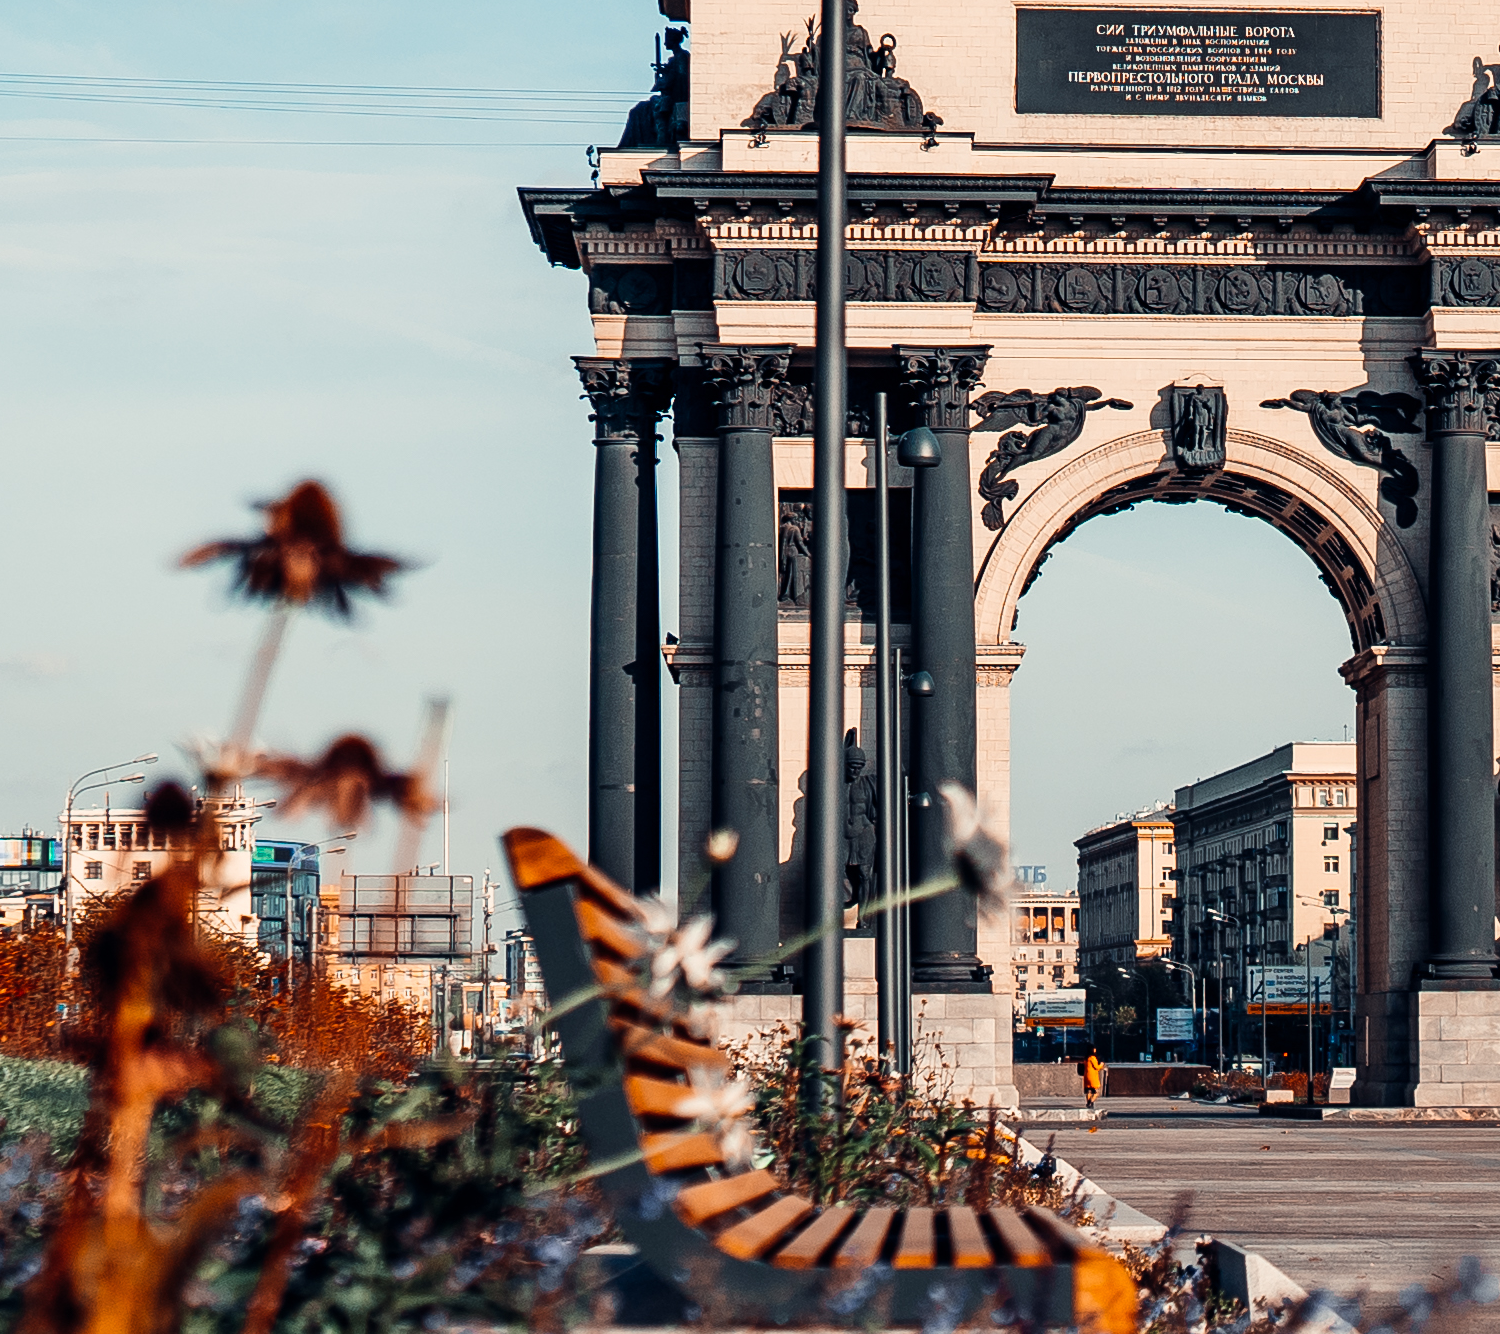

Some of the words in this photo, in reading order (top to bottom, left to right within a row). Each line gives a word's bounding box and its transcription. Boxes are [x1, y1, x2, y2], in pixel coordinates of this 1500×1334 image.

[1097, 24, 1124, 36] СИИ
[1132, 25, 1238, 37] ТРИУМФАЛЬНЫЕ
[1245, 26, 1295, 38] ВОРОТА
[1069, 72, 1214, 83] ПЕРВОПРЕСТОЛЬНОГО
[1221, 73, 1260, 85] ГРАДА
[1267, 74, 1323, 85] МОСКВЫ
